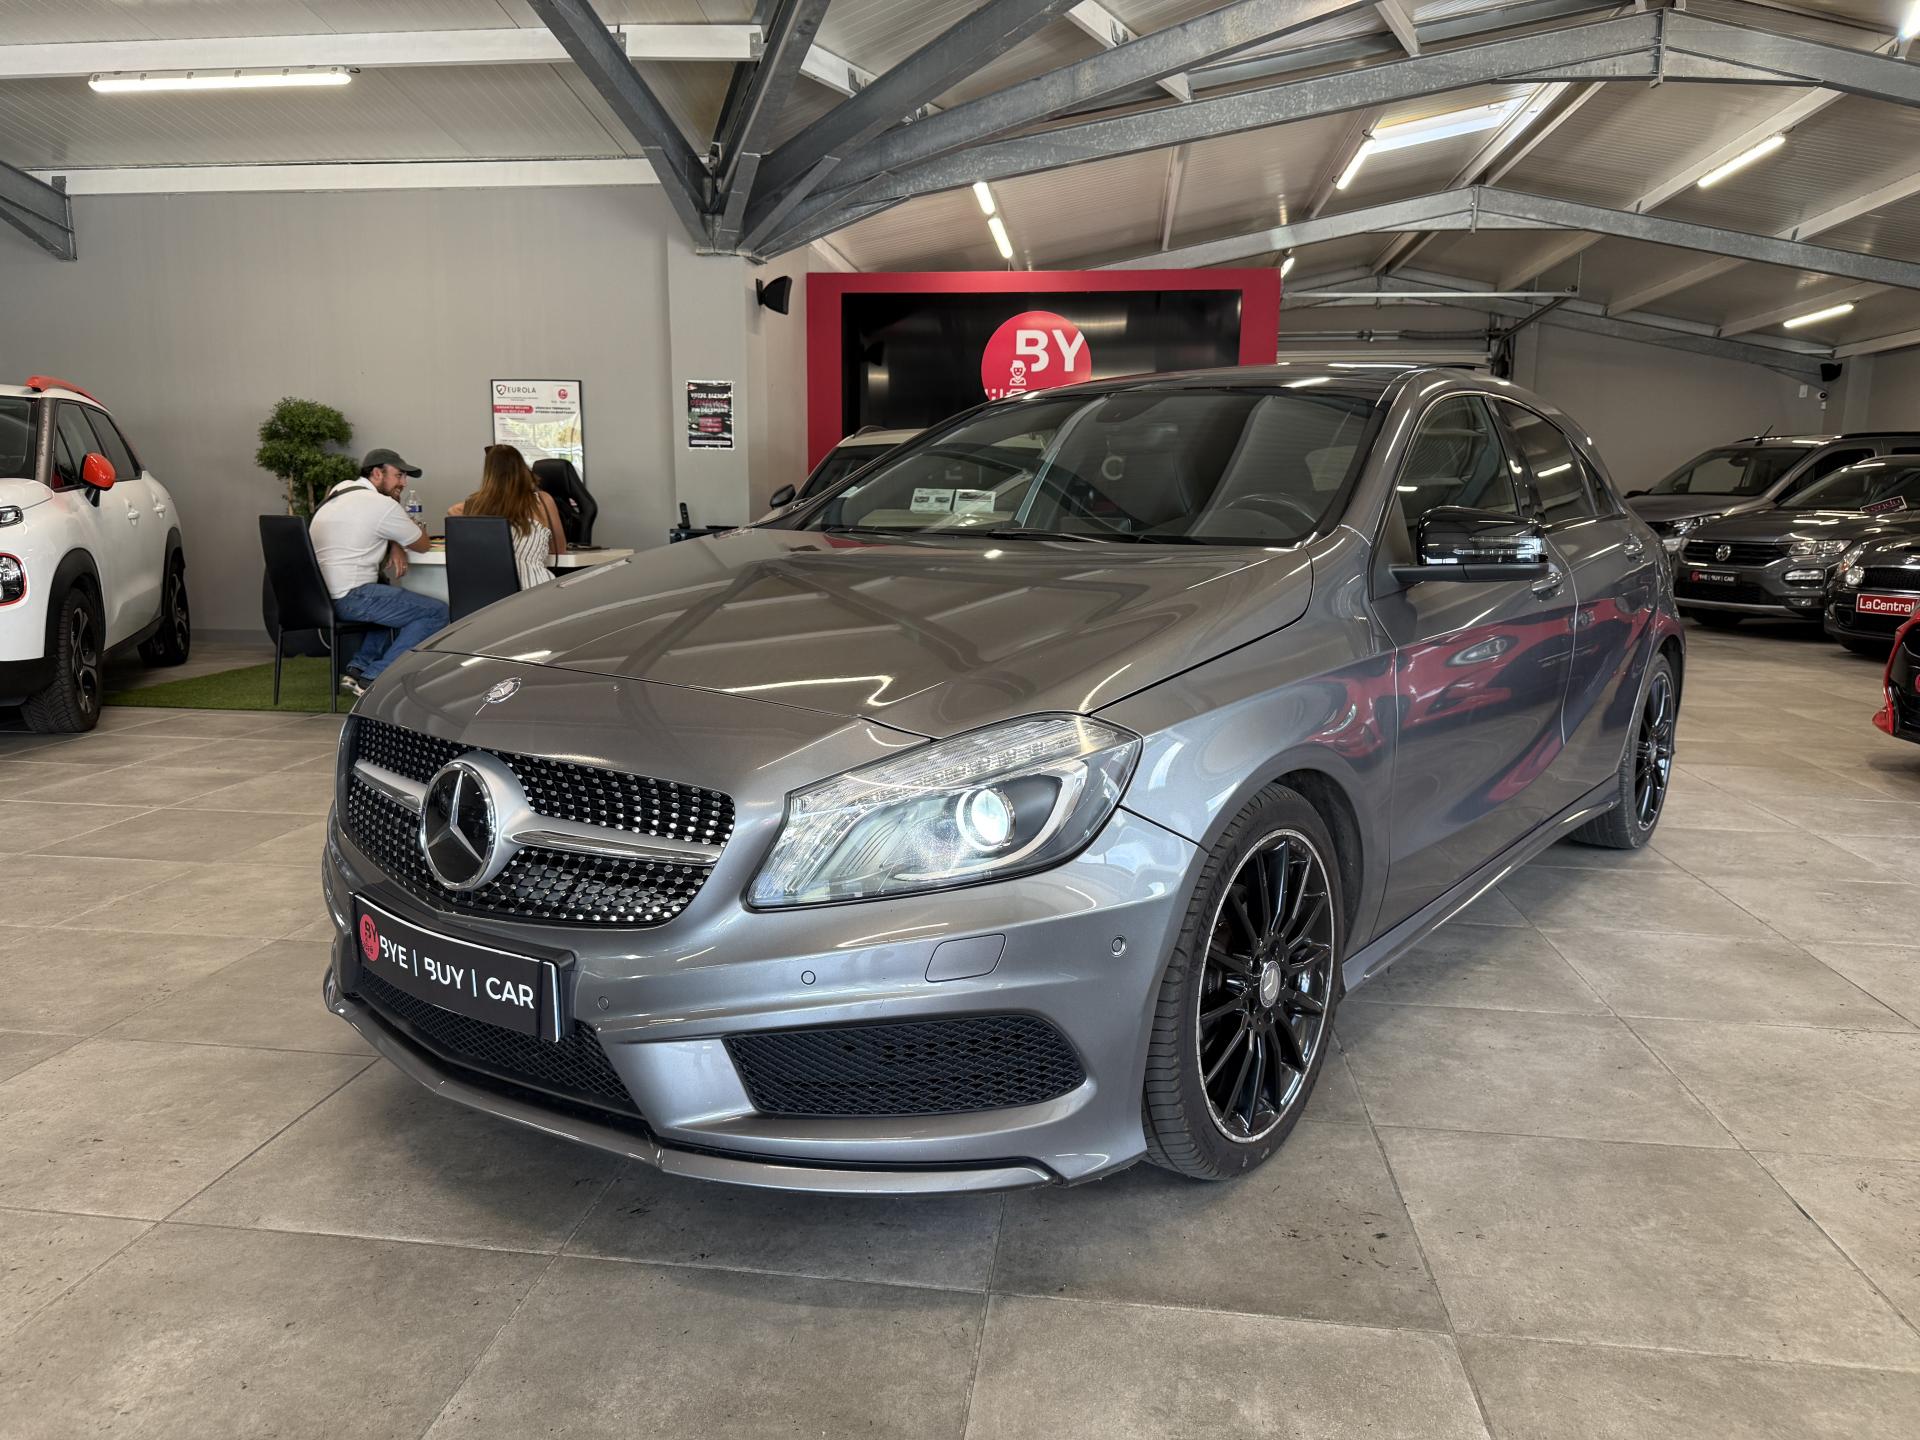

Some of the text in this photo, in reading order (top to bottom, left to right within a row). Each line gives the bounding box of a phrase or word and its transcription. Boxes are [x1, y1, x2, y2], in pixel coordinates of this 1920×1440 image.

[1015, 329, 1085, 373] BY
[507, 386, 537, 394] EUROLA
[379, 935, 535, 1010] BYE BUY CAR
